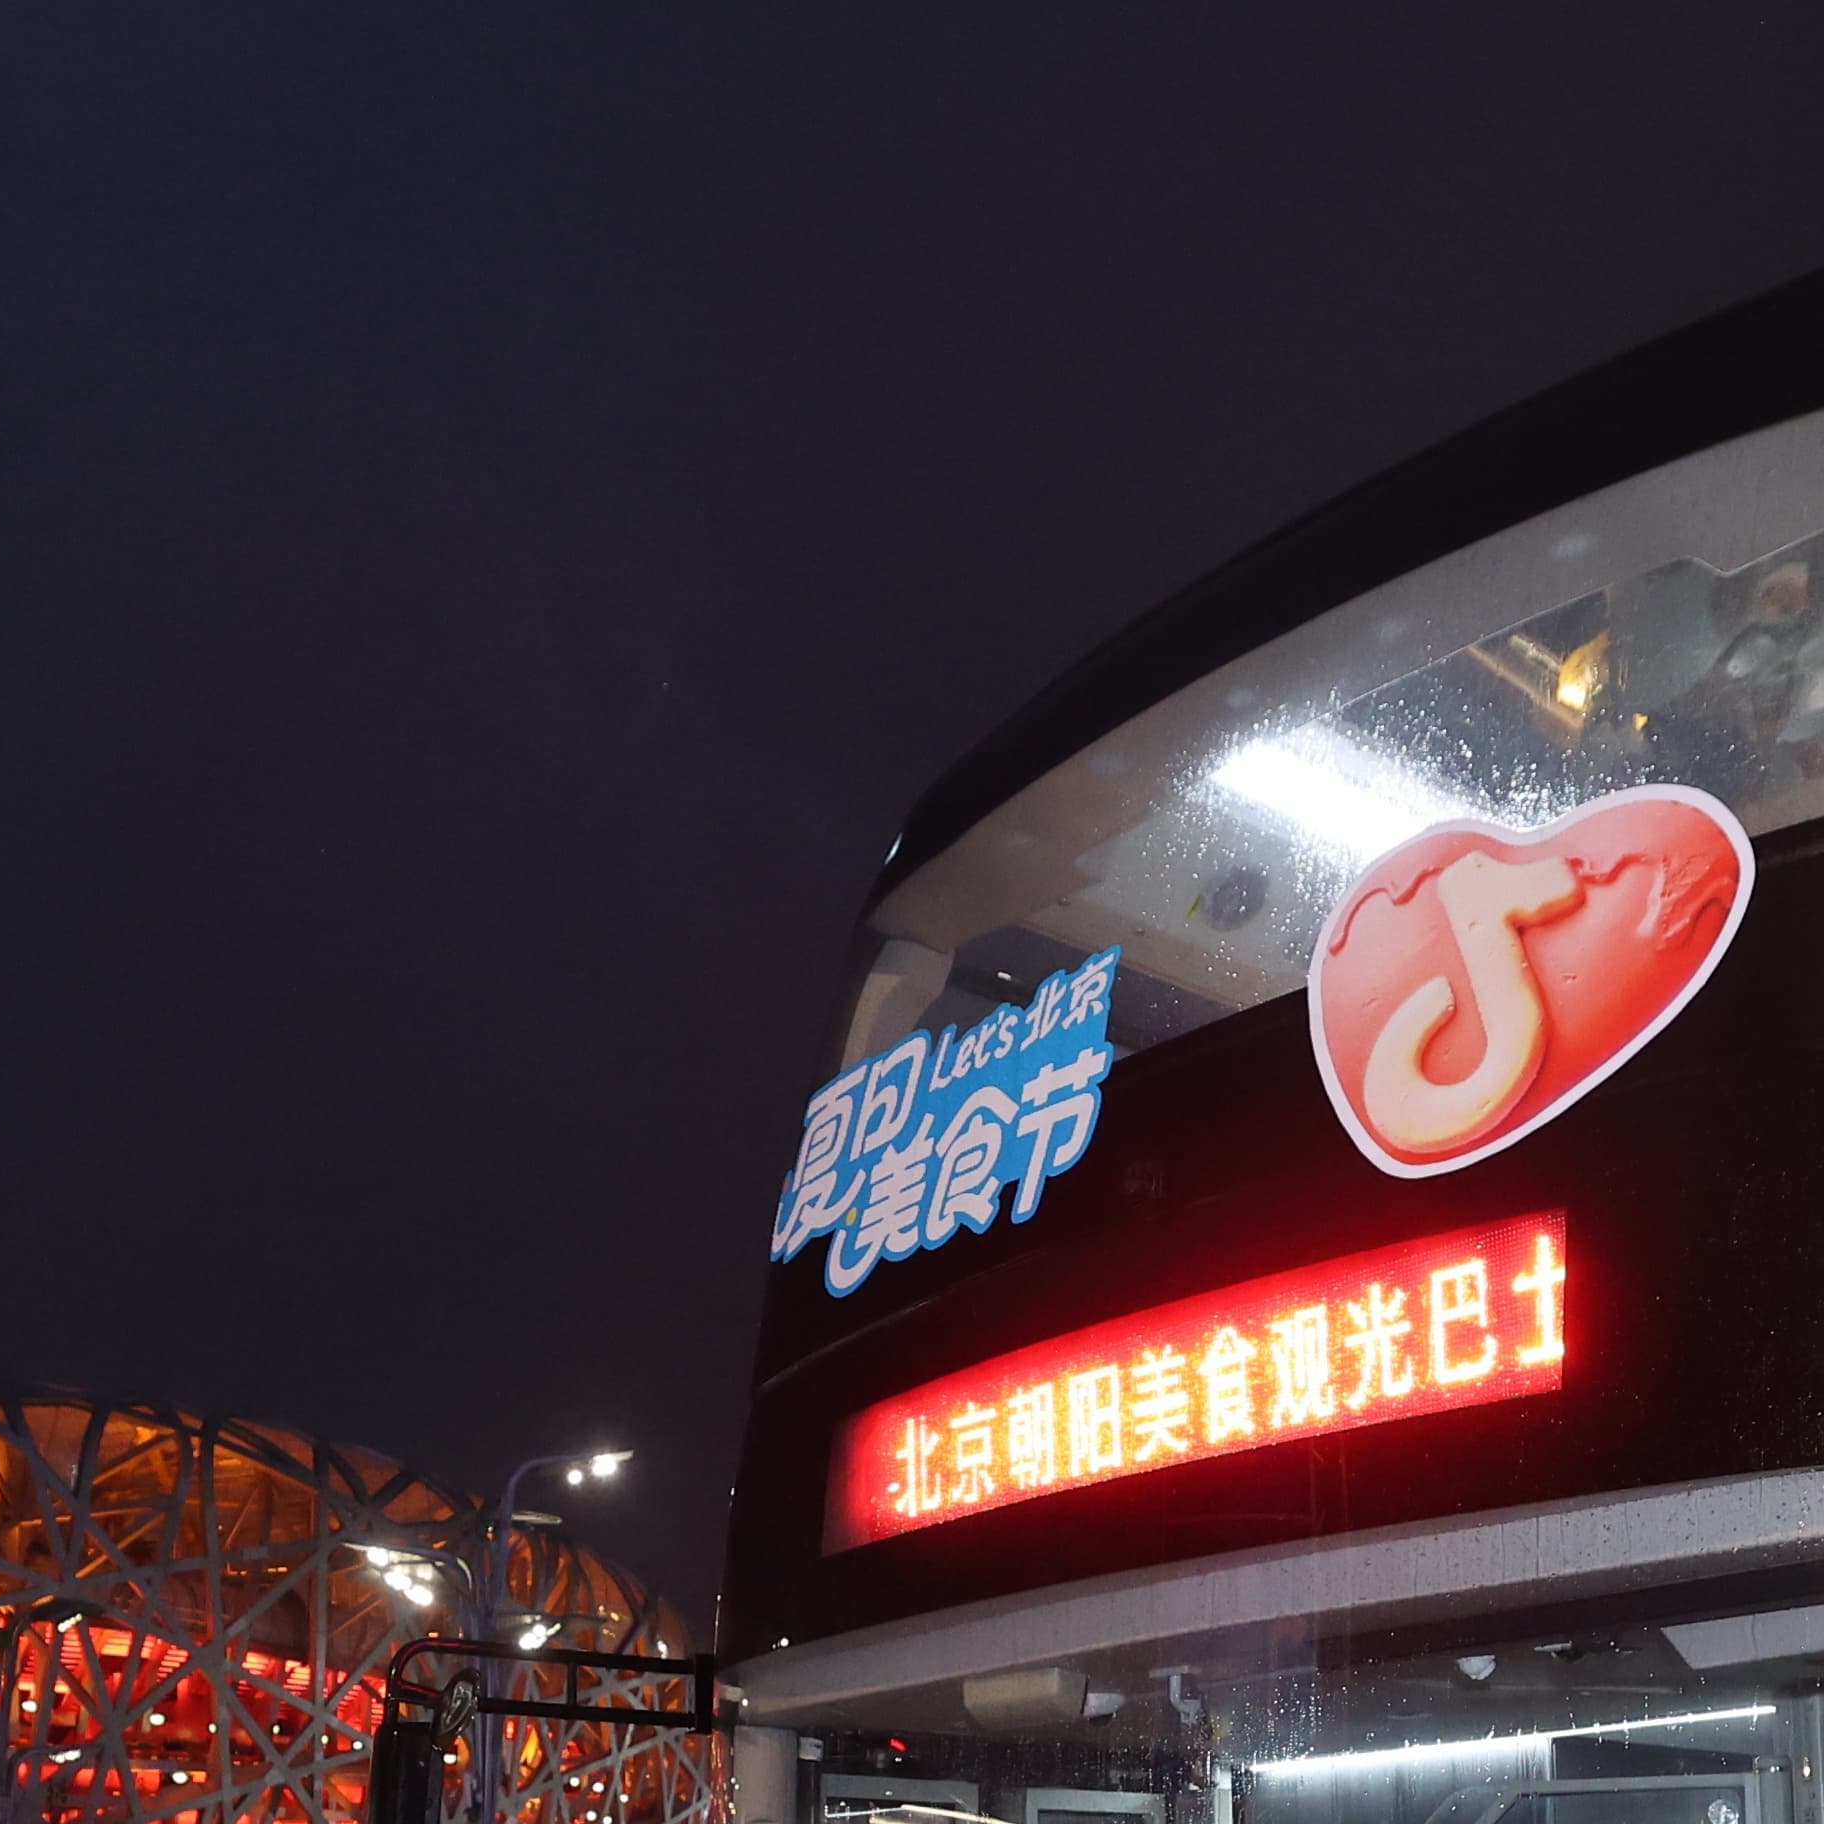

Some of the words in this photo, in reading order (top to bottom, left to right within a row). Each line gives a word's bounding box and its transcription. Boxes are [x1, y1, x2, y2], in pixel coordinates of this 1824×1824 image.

[928, 1010, 1018, 1092] Let's
[1019, 952, 1114, 1051] 北京
[827, 1046, 1098, 1290] 美食节
[886, 1233, 1567, 1520] 北京朝阳美食观光巴士
